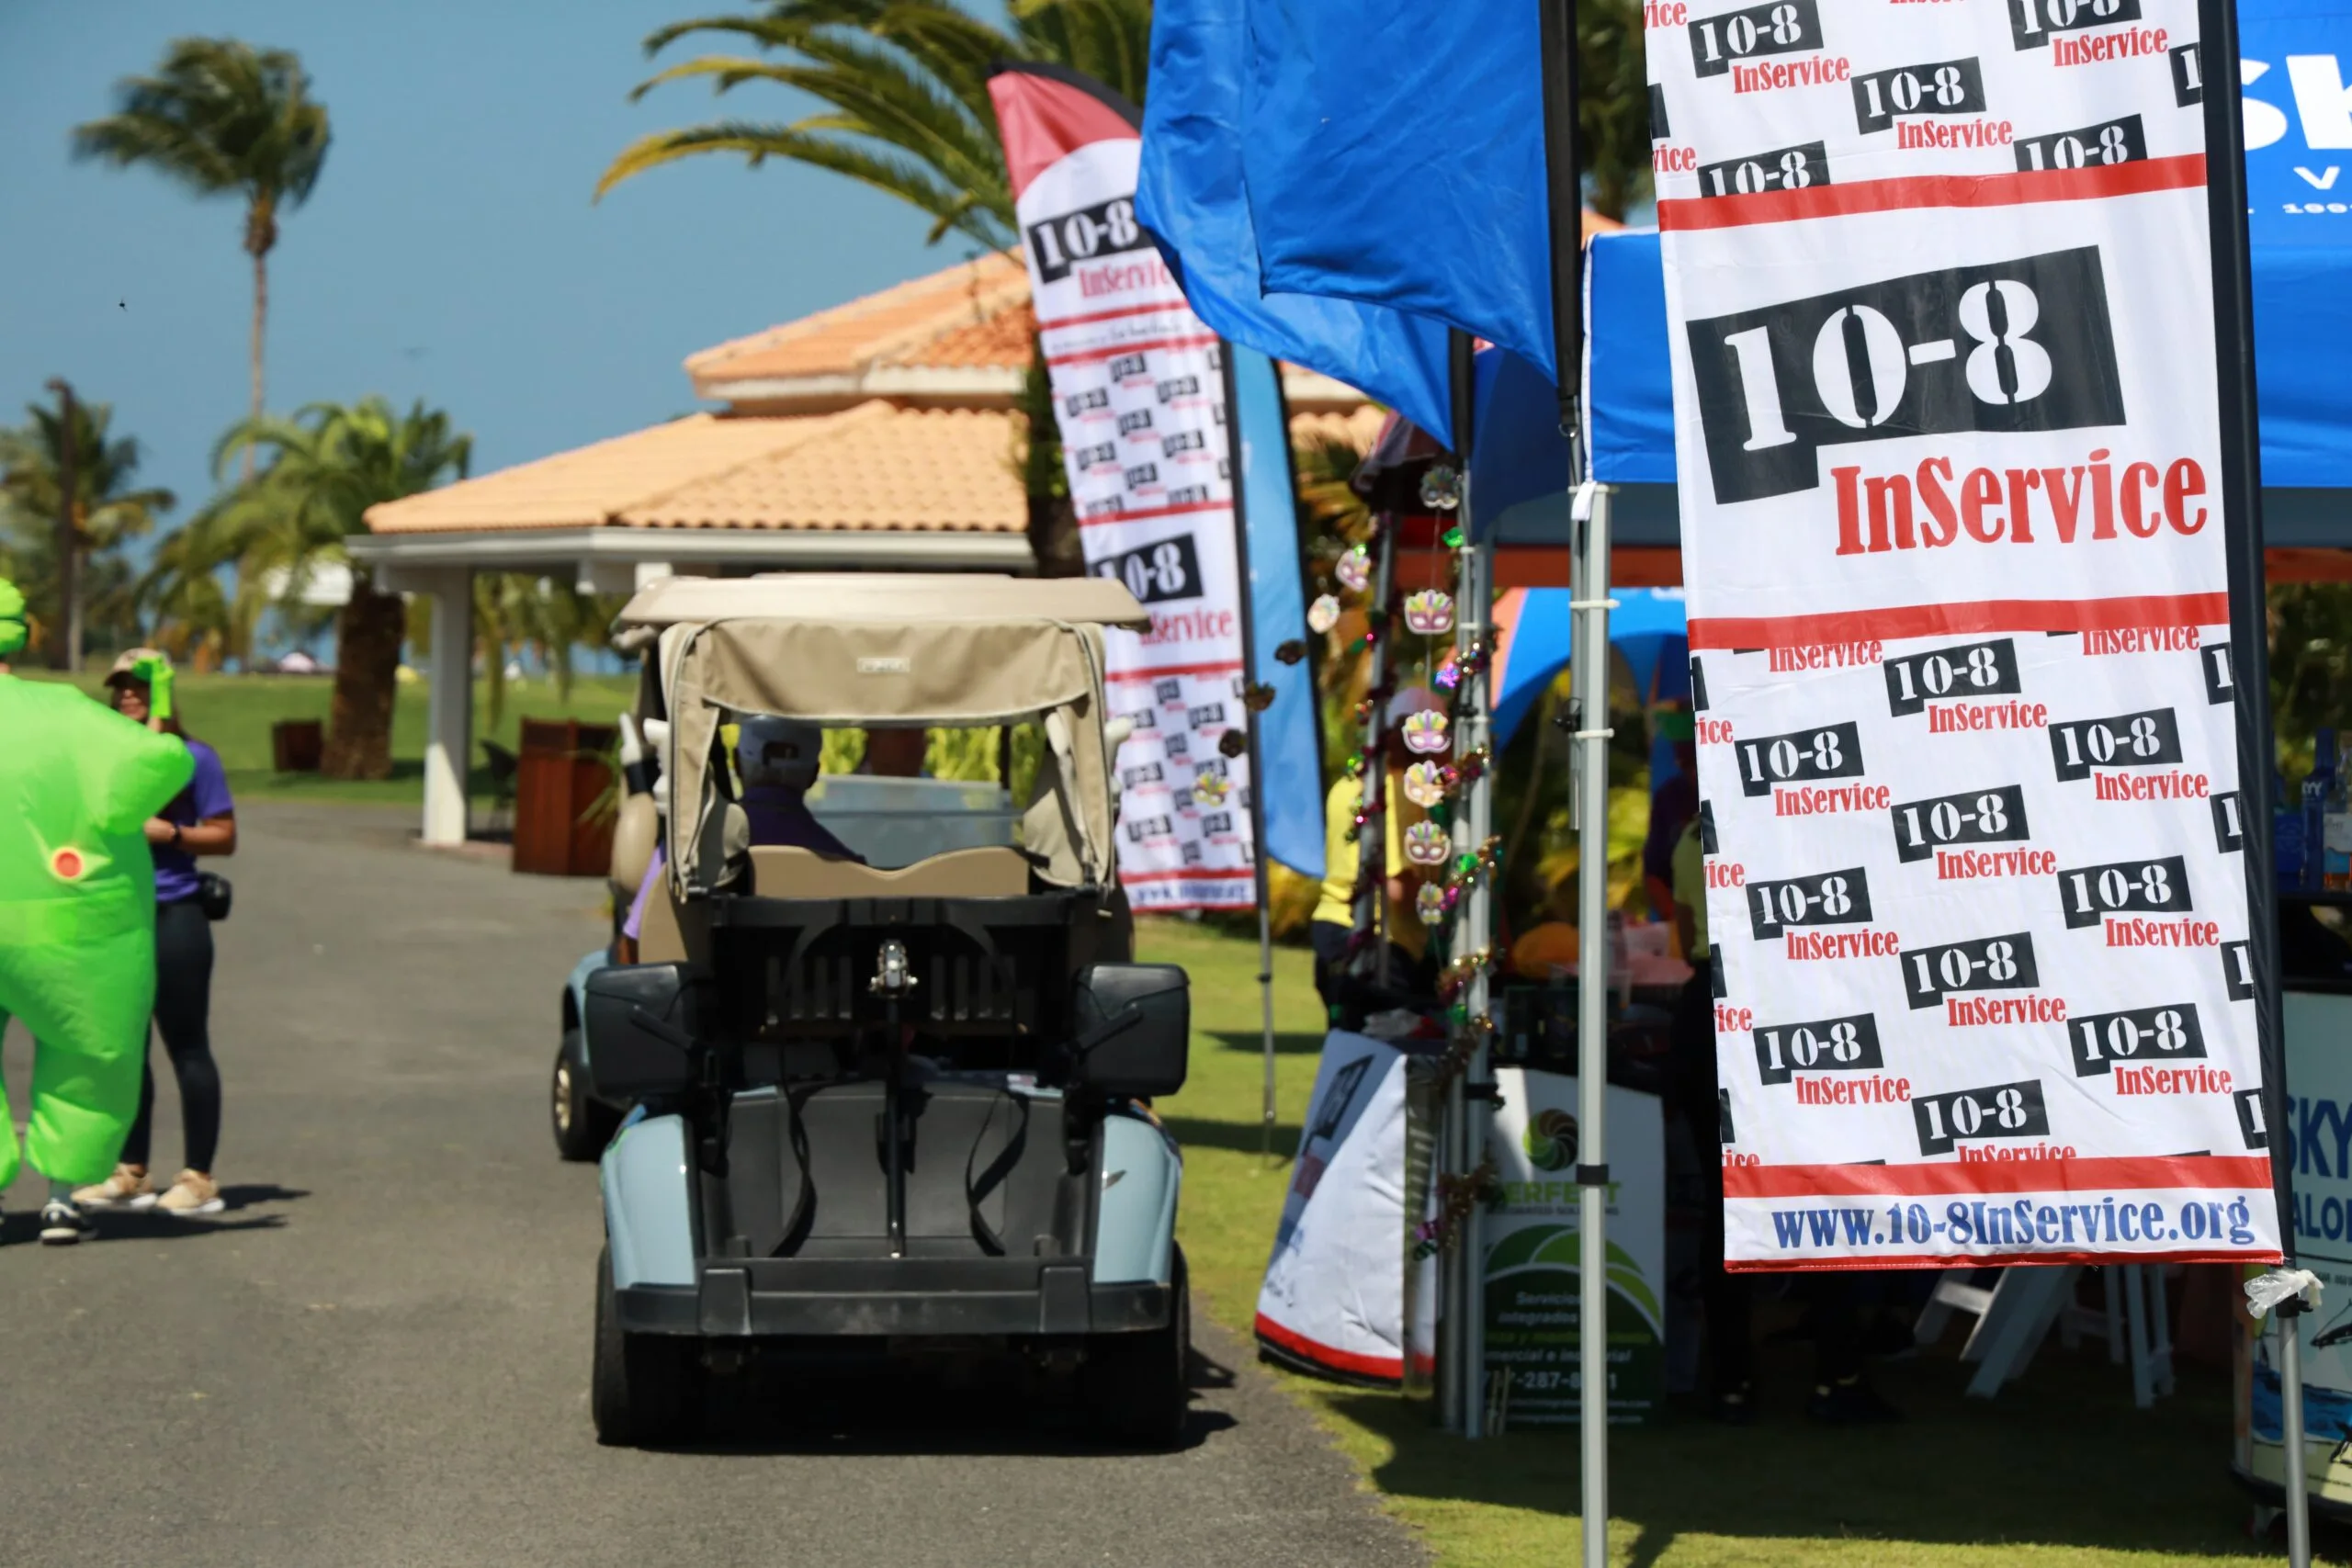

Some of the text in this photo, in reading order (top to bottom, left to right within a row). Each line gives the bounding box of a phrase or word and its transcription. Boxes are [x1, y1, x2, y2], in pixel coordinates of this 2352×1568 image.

[1700, 5, 1802, 62] 10-8
[2054, 28, 2167, 66] InService
[1734, 59, 1849, 93] InService
[1863, 67, 1964, 118] 10-8
[1898, 120, 2011, 149] InService
[2026, 126, 2128, 172] 10-8
[1709, 152, 1810, 197] 10-8
[1035, 199, 1139, 269] 10-8
[1724, 280, 2052, 451] 10-8
[1832, 448, 2207, 556] InService
[1099, 542, 1187, 602] 0-8
[1895, 648, 1999, 700] 10-8
[1928, 701, 2046, 733] InService
[1745, 731, 1842, 782] 10-8
[2061, 717, 2160, 765] 10-8
[1775, 784, 1890, 816] InService
[2095, 771, 2208, 800] InService
[1903, 795, 2007, 846] 10-8
[1938, 847, 2055, 879] InService
[1758, 877, 1851, 924] 10-8
[2070, 865, 2171, 912] 10-8
[1787, 929, 1899, 960] InService
[2105, 918, 2219, 947] InService
[1913, 942, 2017, 993] 10-8
[1947, 994, 2066, 1026] InService
[1765, 1022, 1860, 1069] 10-8
[2080, 1010, 2187, 1060] 10-8
[1795, 1075, 1910, 1105] InService
[2114, 1064, 2232, 1095] InService
[1924, 1089, 2027, 1139] 10-8
[1773, 1196, 2255, 1247] www.10-8InService.org
